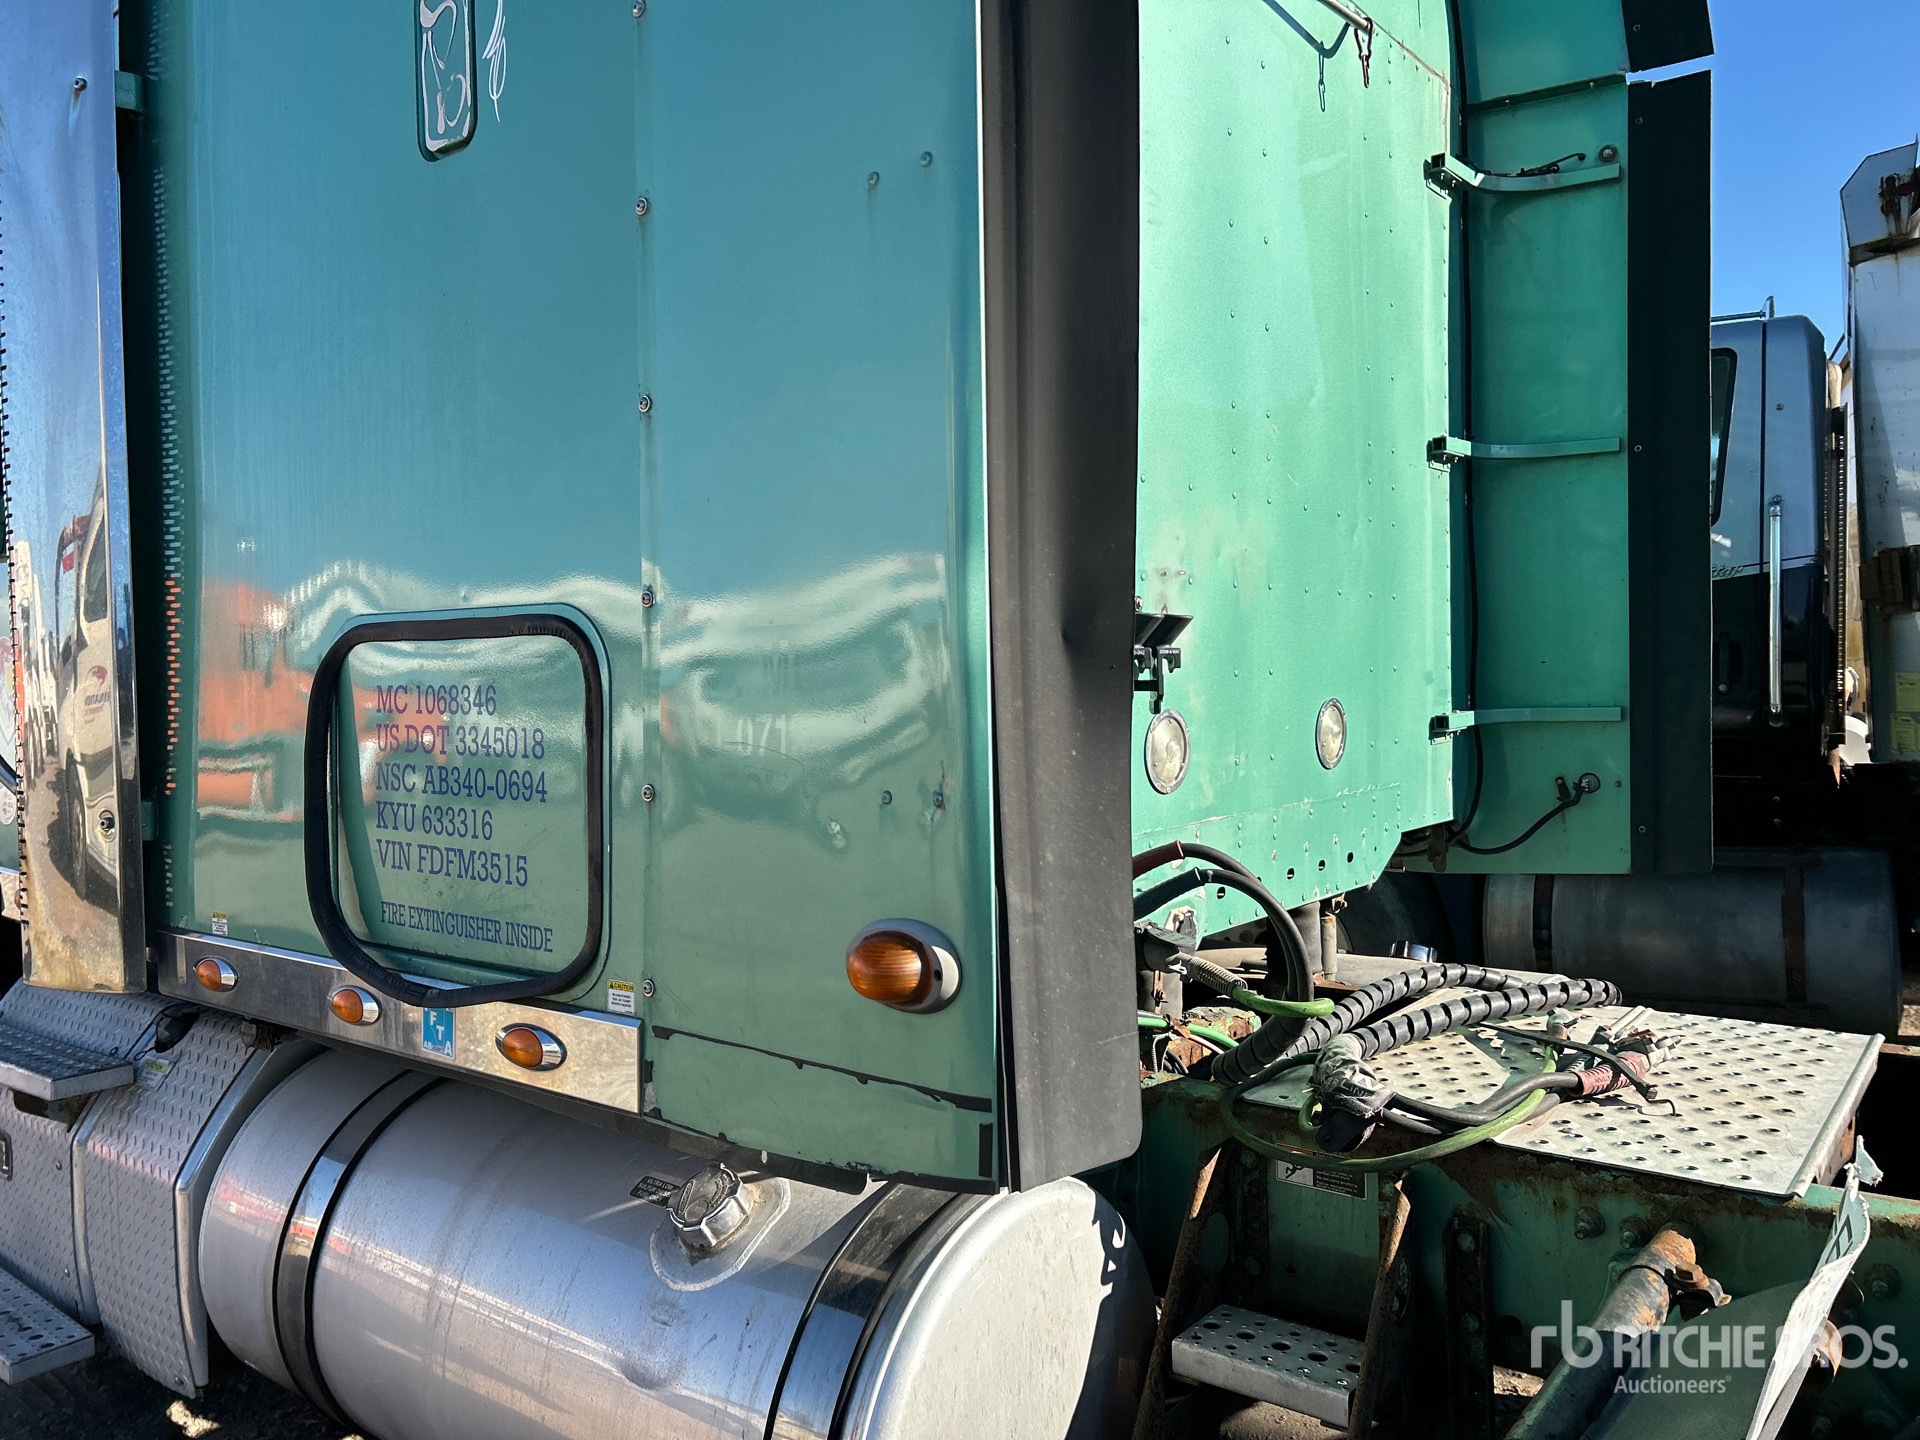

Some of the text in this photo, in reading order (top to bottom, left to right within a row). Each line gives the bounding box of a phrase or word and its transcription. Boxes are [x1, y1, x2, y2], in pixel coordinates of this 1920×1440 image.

[376, 684, 497, 716] MC 1068346
[376, 723, 545, 760] US DOT 3345018
[376, 762, 547, 803] NSC AB340-0694
[376, 801, 493, 841] KYU 633316
[376, 838, 528, 887] VIN FDFM3515
[381, 901, 553, 953] FIRE EXTINGUISHER INSIDE
